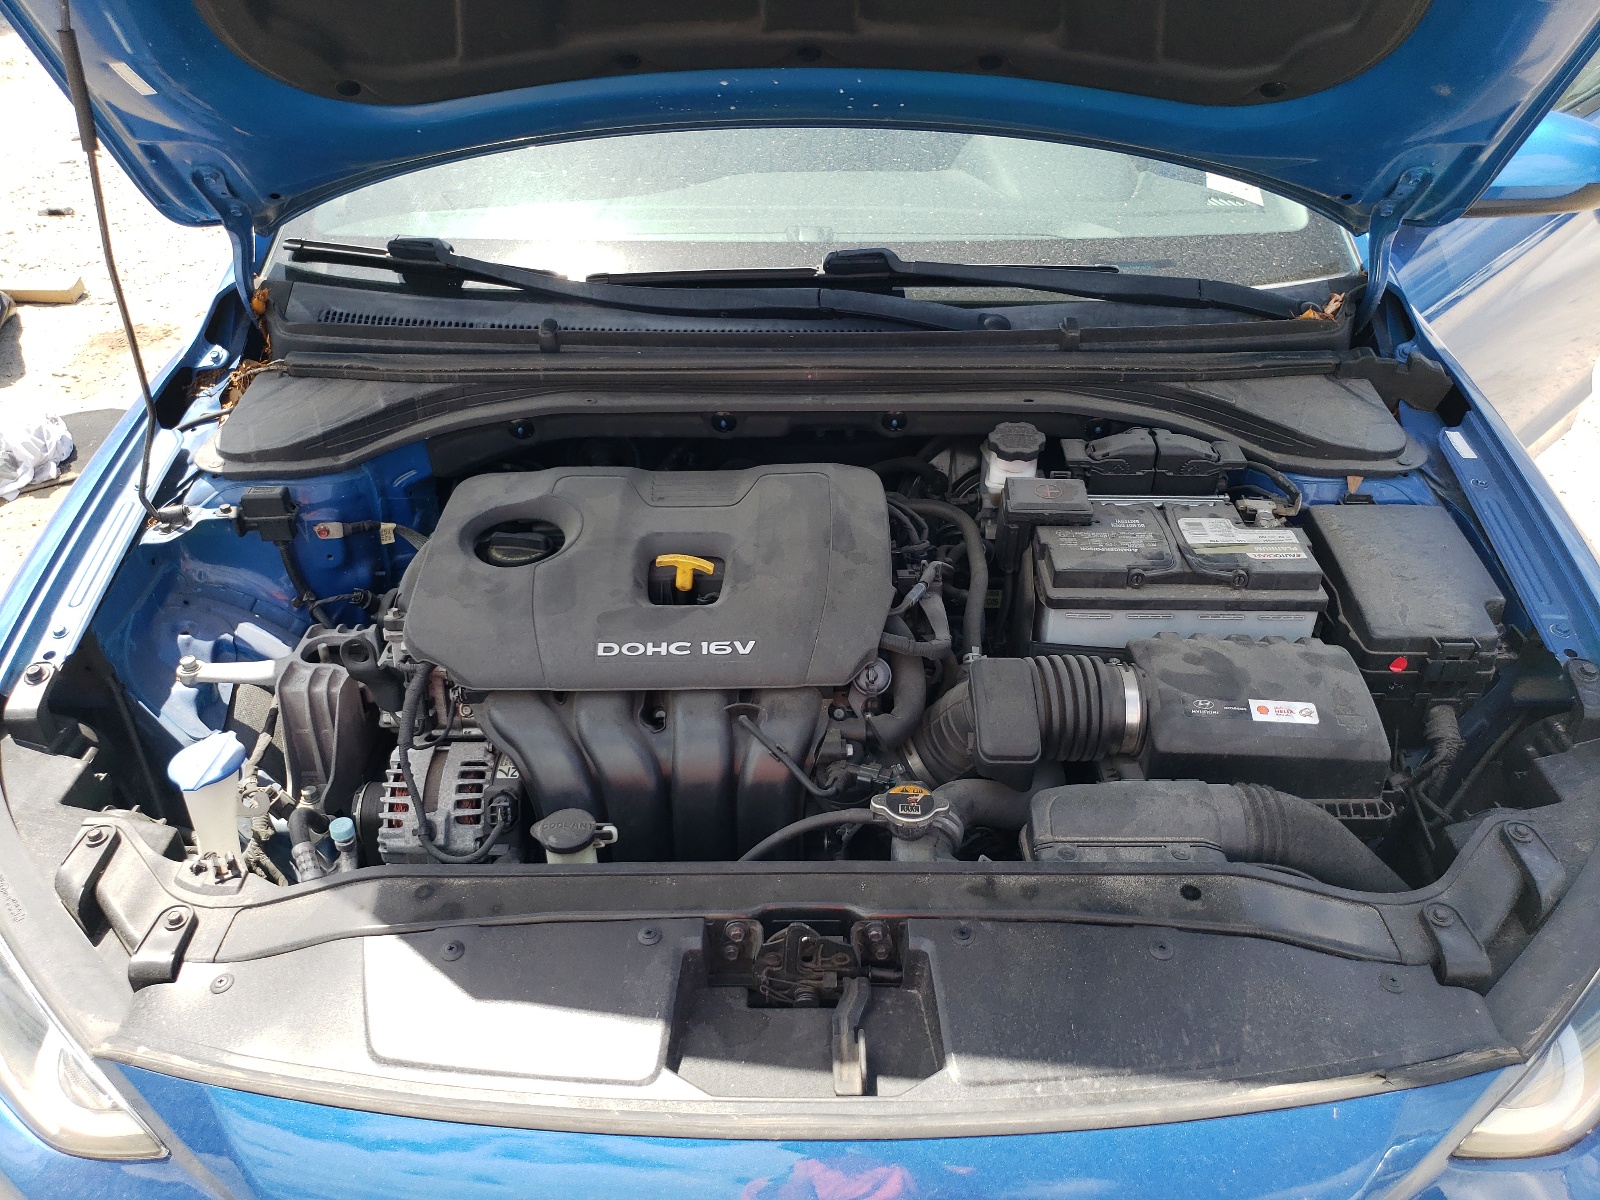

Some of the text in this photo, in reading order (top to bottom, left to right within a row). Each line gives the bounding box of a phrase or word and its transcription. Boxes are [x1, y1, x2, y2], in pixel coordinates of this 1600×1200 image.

[597, 640, 756, 656] DOHC 16V
[542, 821, 595, 830] COOLANT
